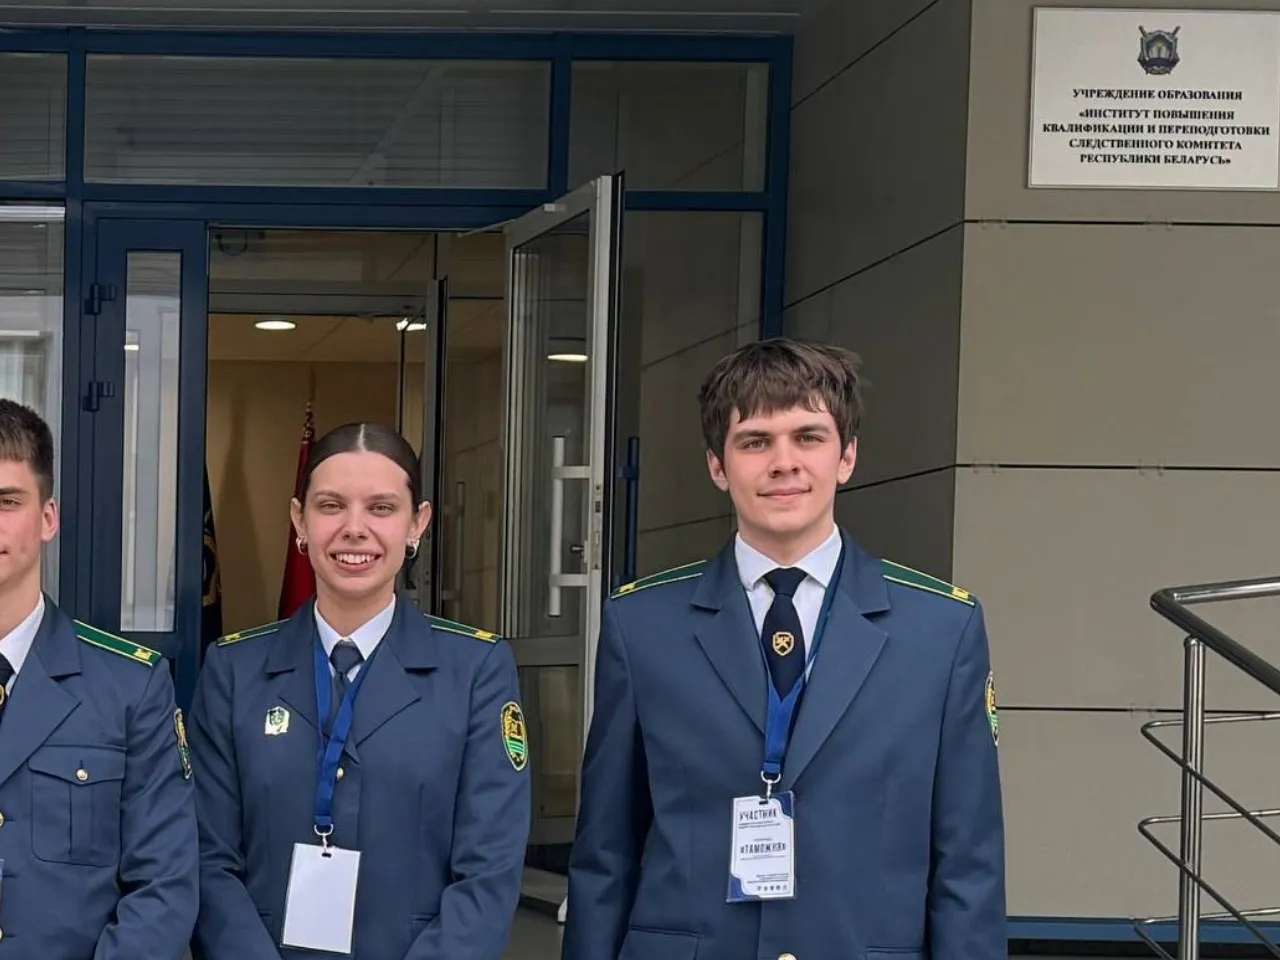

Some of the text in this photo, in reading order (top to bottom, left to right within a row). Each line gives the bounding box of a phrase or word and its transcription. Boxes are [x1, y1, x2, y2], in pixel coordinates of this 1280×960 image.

[1073, 89, 1243, 101] УЧРЕЖДЕНИЕ ОБРАЗОВАНИЯ
[1079, 109, 1235, 120] «ИНСТИТУТ ПОВЫШЕНИЯ
[1043, 124, 1270, 136] КВАЛИФИКАЦИИ И ПЕРЕПОДГОТОВКИ
[1069, 139, 1242, 150] СЛЕДСТВЕННОГО КОМИТЕТА
[1080, 154, 1231, 165] РЕСПУБЛИКИ БЕЛАРУСЬ»
